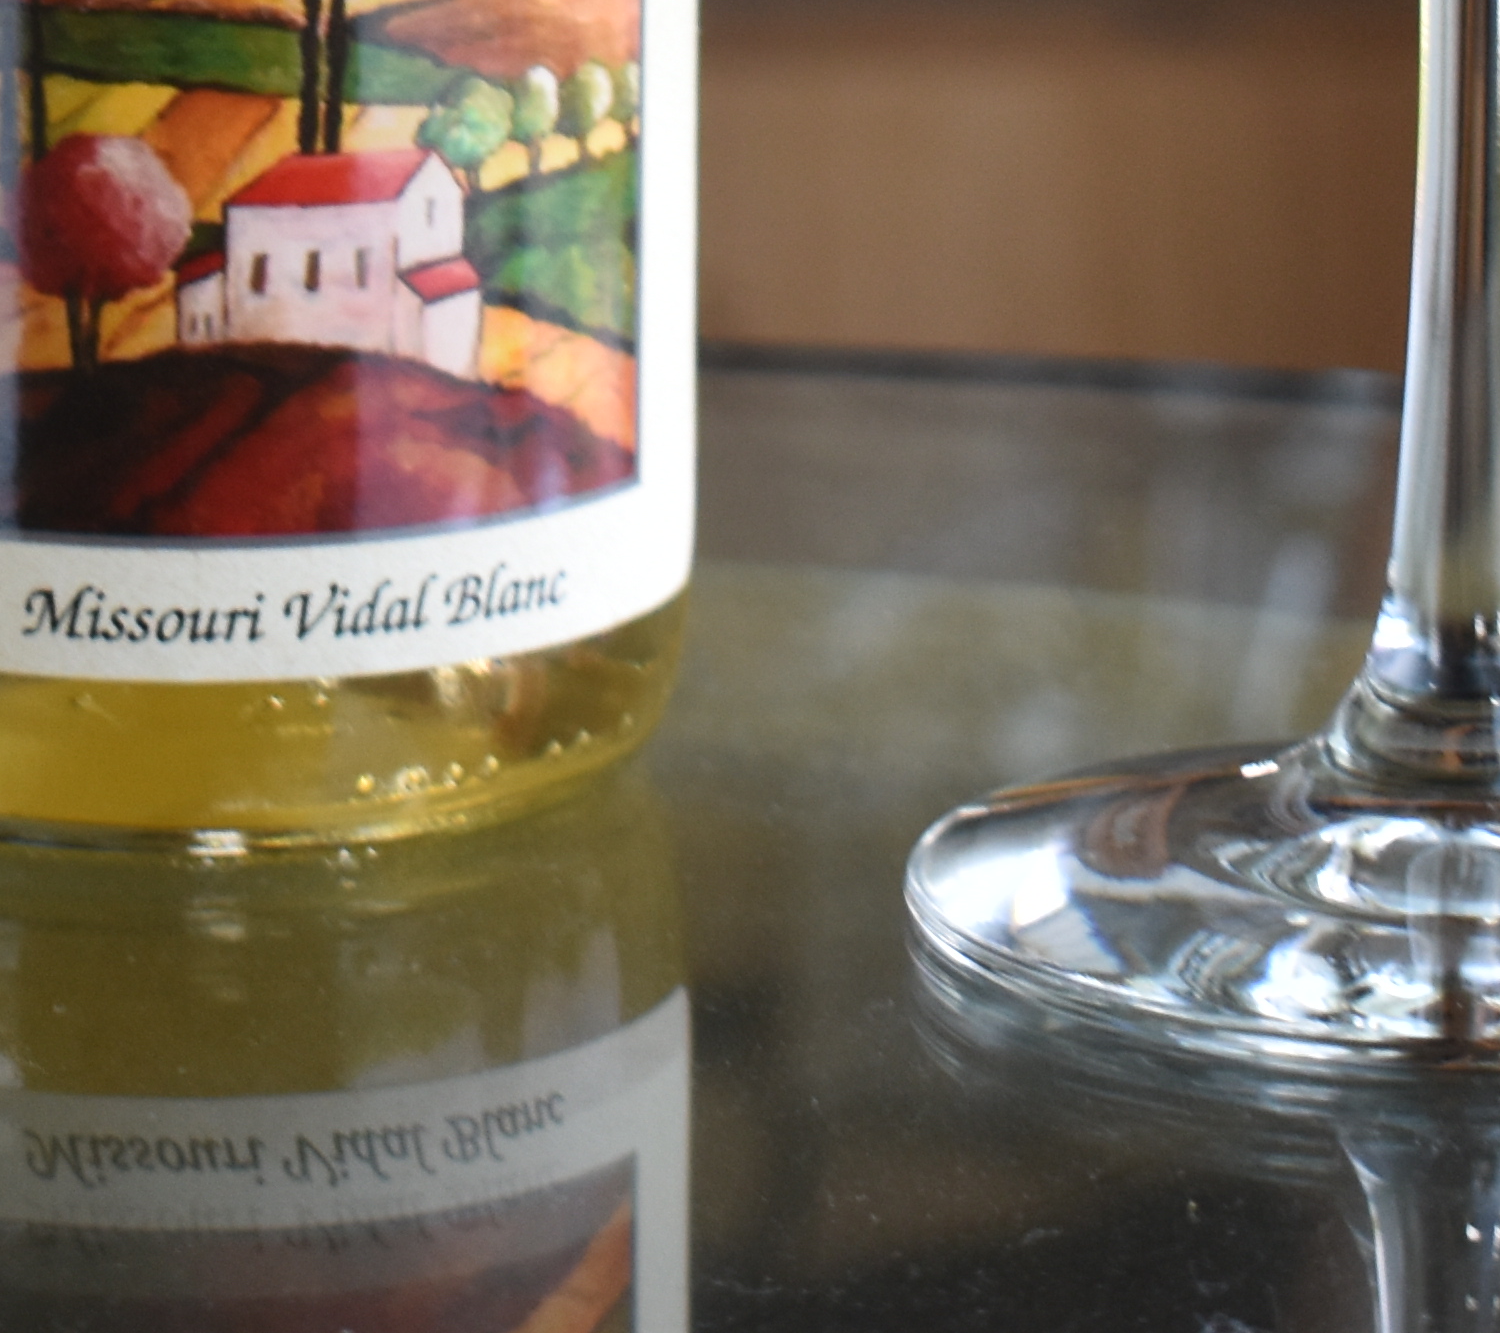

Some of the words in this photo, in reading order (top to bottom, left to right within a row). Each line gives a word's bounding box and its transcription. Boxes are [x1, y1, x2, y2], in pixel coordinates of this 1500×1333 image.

[19, 585, 268, 645] Missouri
[282, 581, 433, 645] Vidal
[441, 559, 570, 627] Blanc
